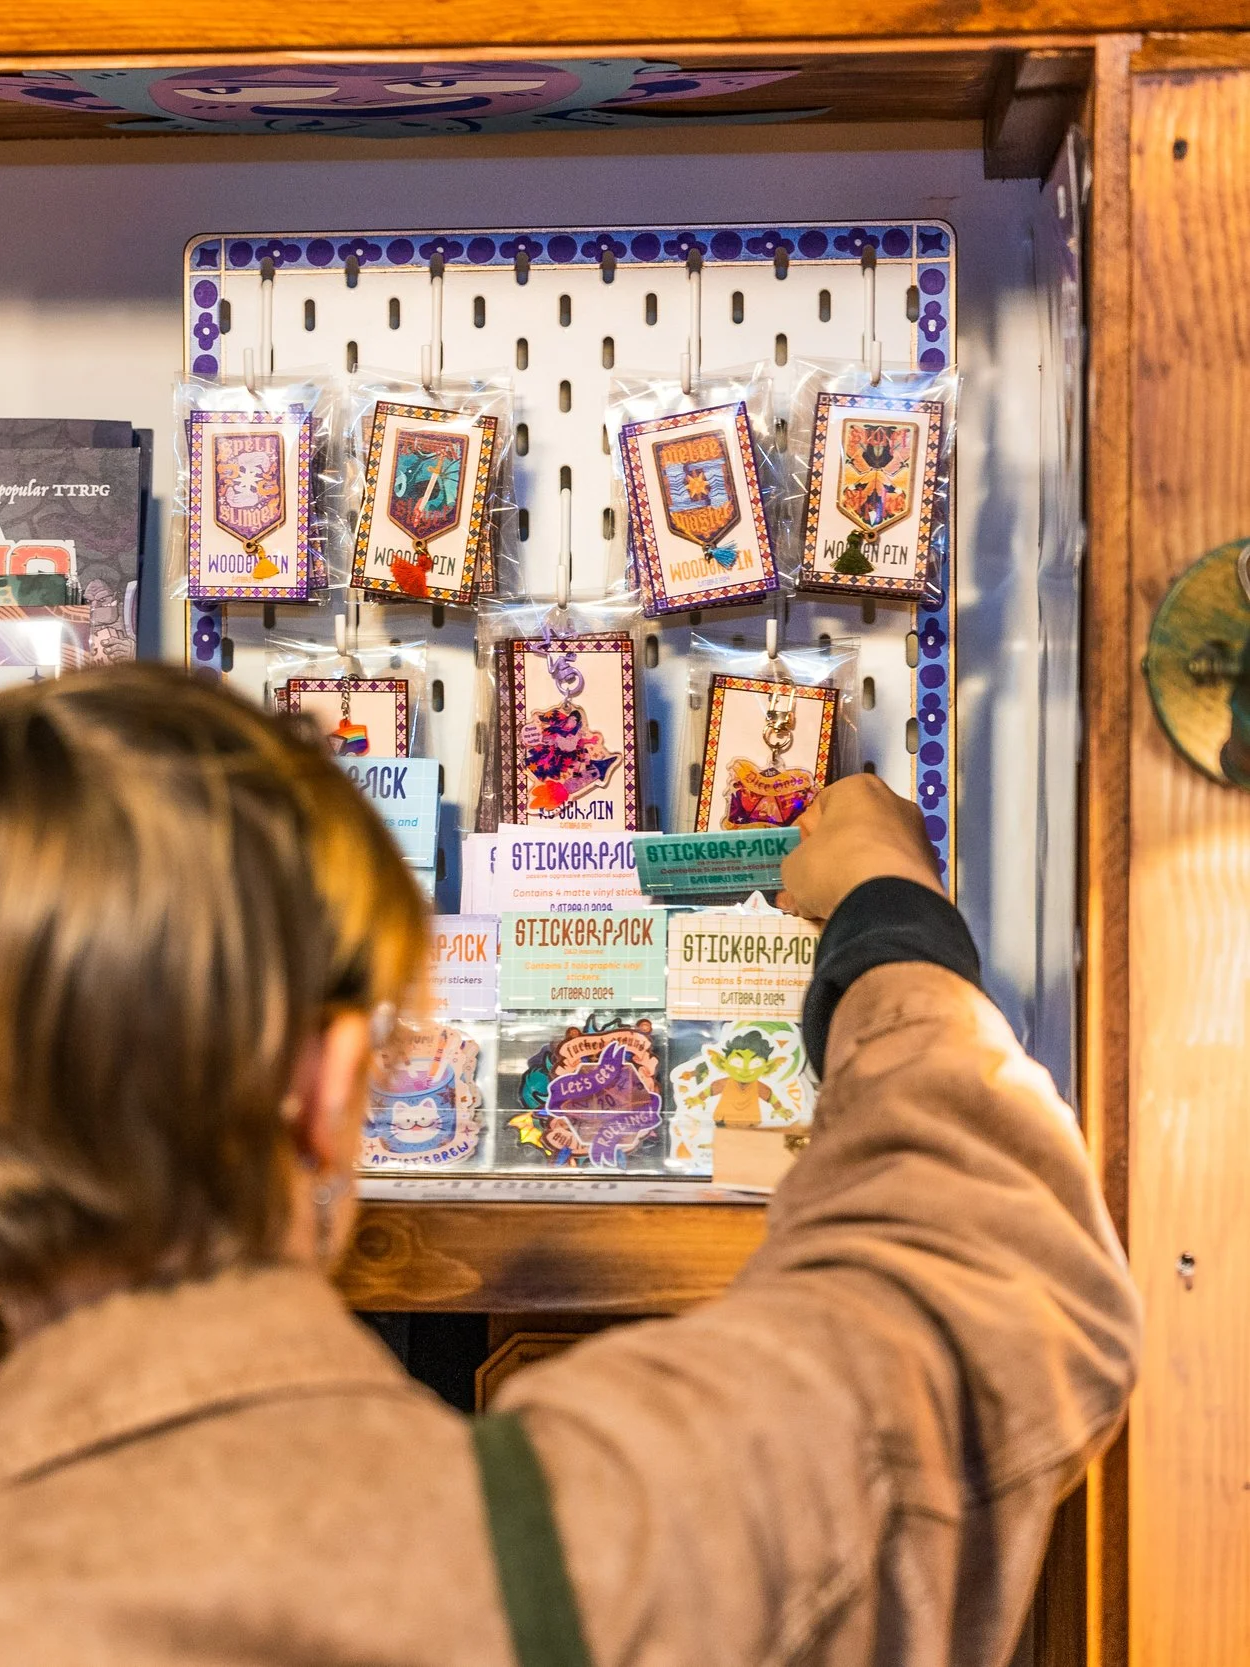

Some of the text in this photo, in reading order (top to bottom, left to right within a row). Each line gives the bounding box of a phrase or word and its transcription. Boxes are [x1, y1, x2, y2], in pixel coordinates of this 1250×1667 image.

[52, 484, 110, 497] TTRPG
[824, 540, 908, 565] WOEN PIN
[266, 555, 289, 574] IN
[430, 554, 456, 576] PIN
[398, 817, 418, 826] and
[512, 842, 636, 870] STICKERPAC
[513, 888, 552, 898] Contains
[564, 888, 590, 896] matte
[593, 888, 614, 898] vinyl
[616, 888, 643, 896] sticke
[524, 962, 561, 970] Contains
[572, 962, 620, 971] holographic
[448, 976, 483, 984] stickers
[692, 976, 809, 987] Contains 5 matte sticker
[592, 987, 614, 1000] 2024
[763, 992, 786, 1006] 2024
[432, 1142, 468, 1163] BREW
